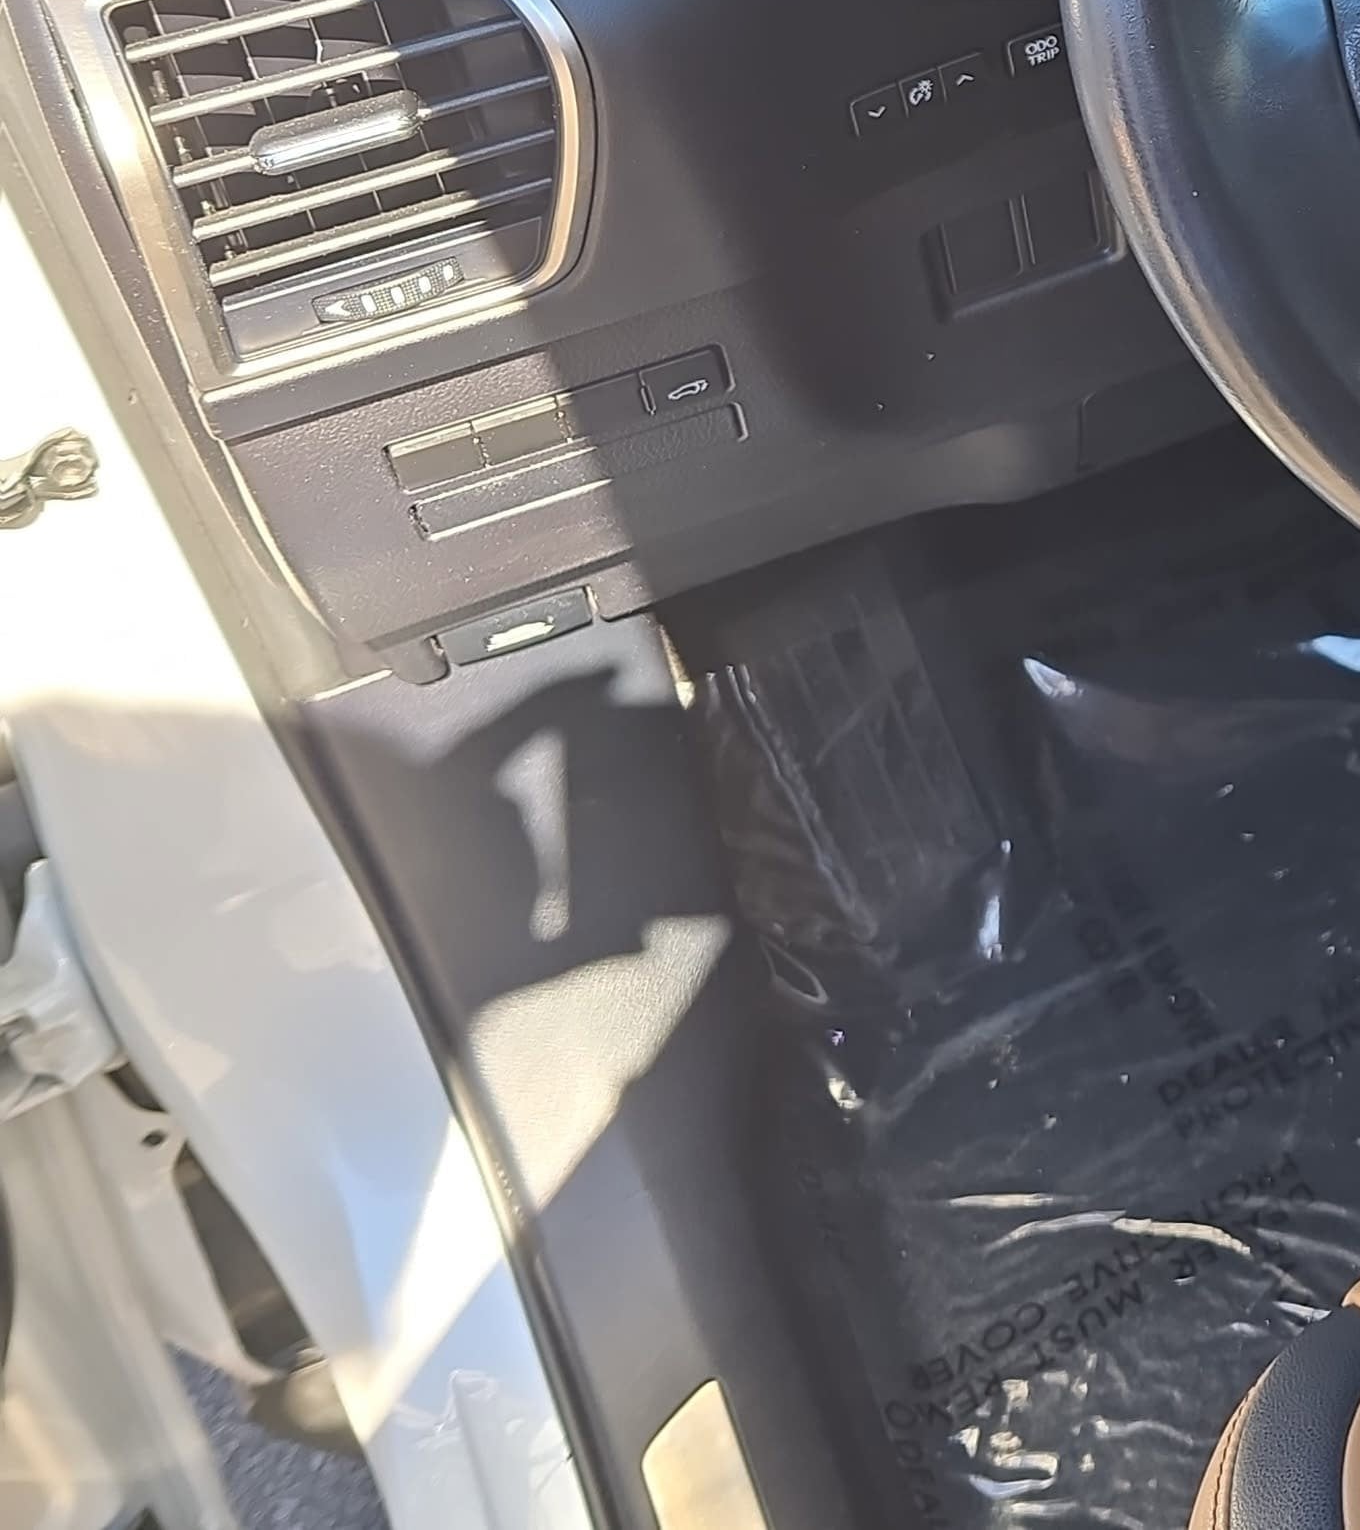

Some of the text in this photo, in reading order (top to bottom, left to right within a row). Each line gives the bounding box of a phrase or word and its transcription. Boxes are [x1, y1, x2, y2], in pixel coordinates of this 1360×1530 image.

[1025, 35, 1058, 55] ODO
[1028, 46, 1060, 66] TRIP
[911, 1301, 1046, 1391] COVER
[1034, 1280, 1143, 1370] MUST
